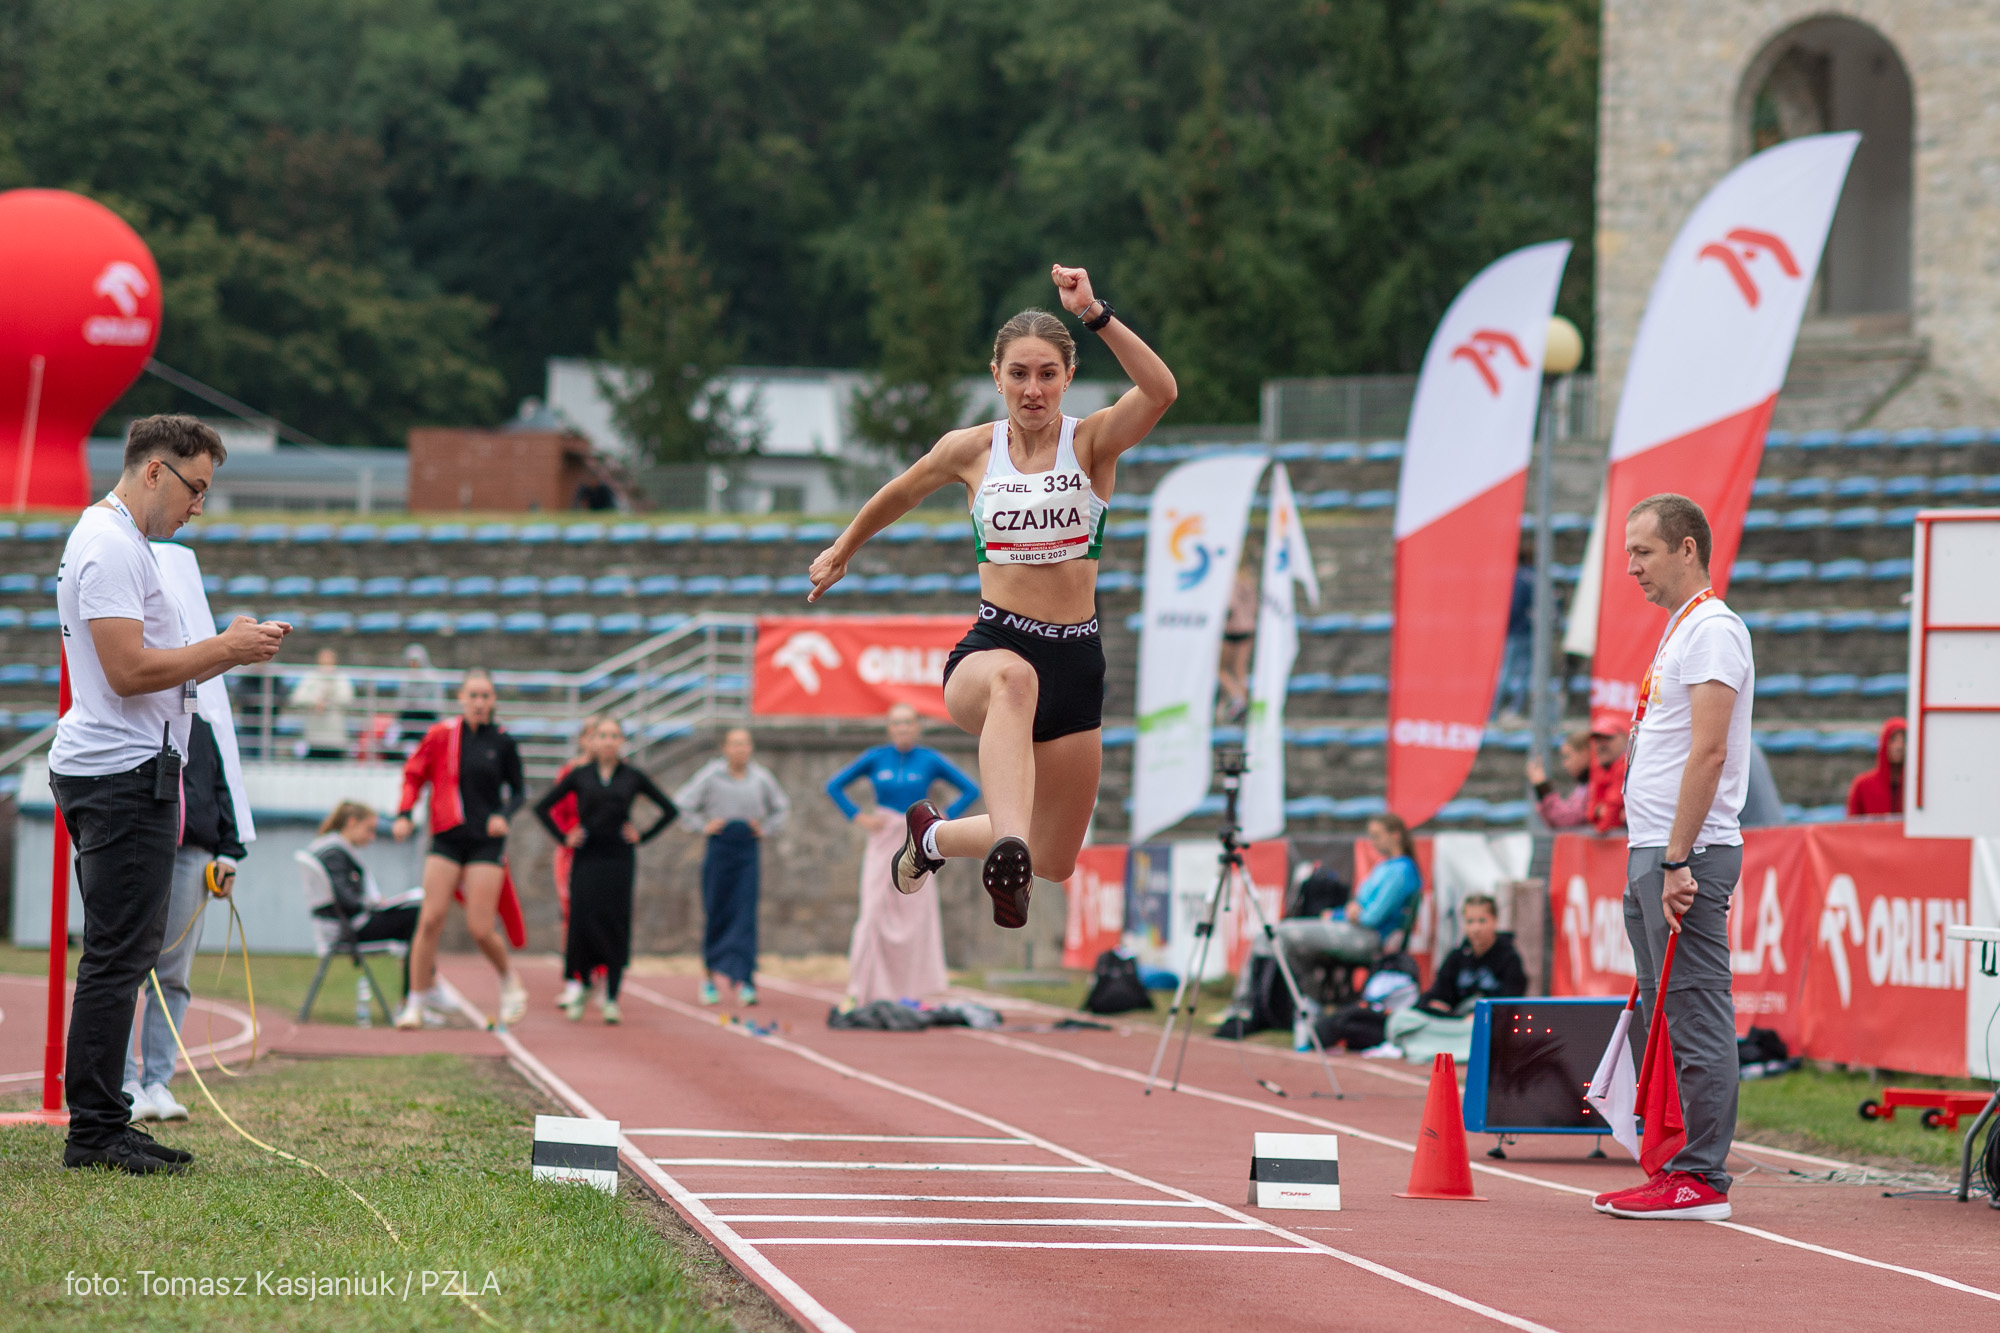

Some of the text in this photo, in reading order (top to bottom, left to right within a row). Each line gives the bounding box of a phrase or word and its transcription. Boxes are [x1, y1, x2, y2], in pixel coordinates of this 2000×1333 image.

[1043, 473, 1082, 493] 334
[992, 507, 1082, 531] CZAJKA
[1010, 550, 1067, 561] SŁUBICE 2023
[1002, 613, 1062, 638] NIKE
[1062, 618, 1098, 639] PRO
[1866, 894, 1967, 991] ORLEN
